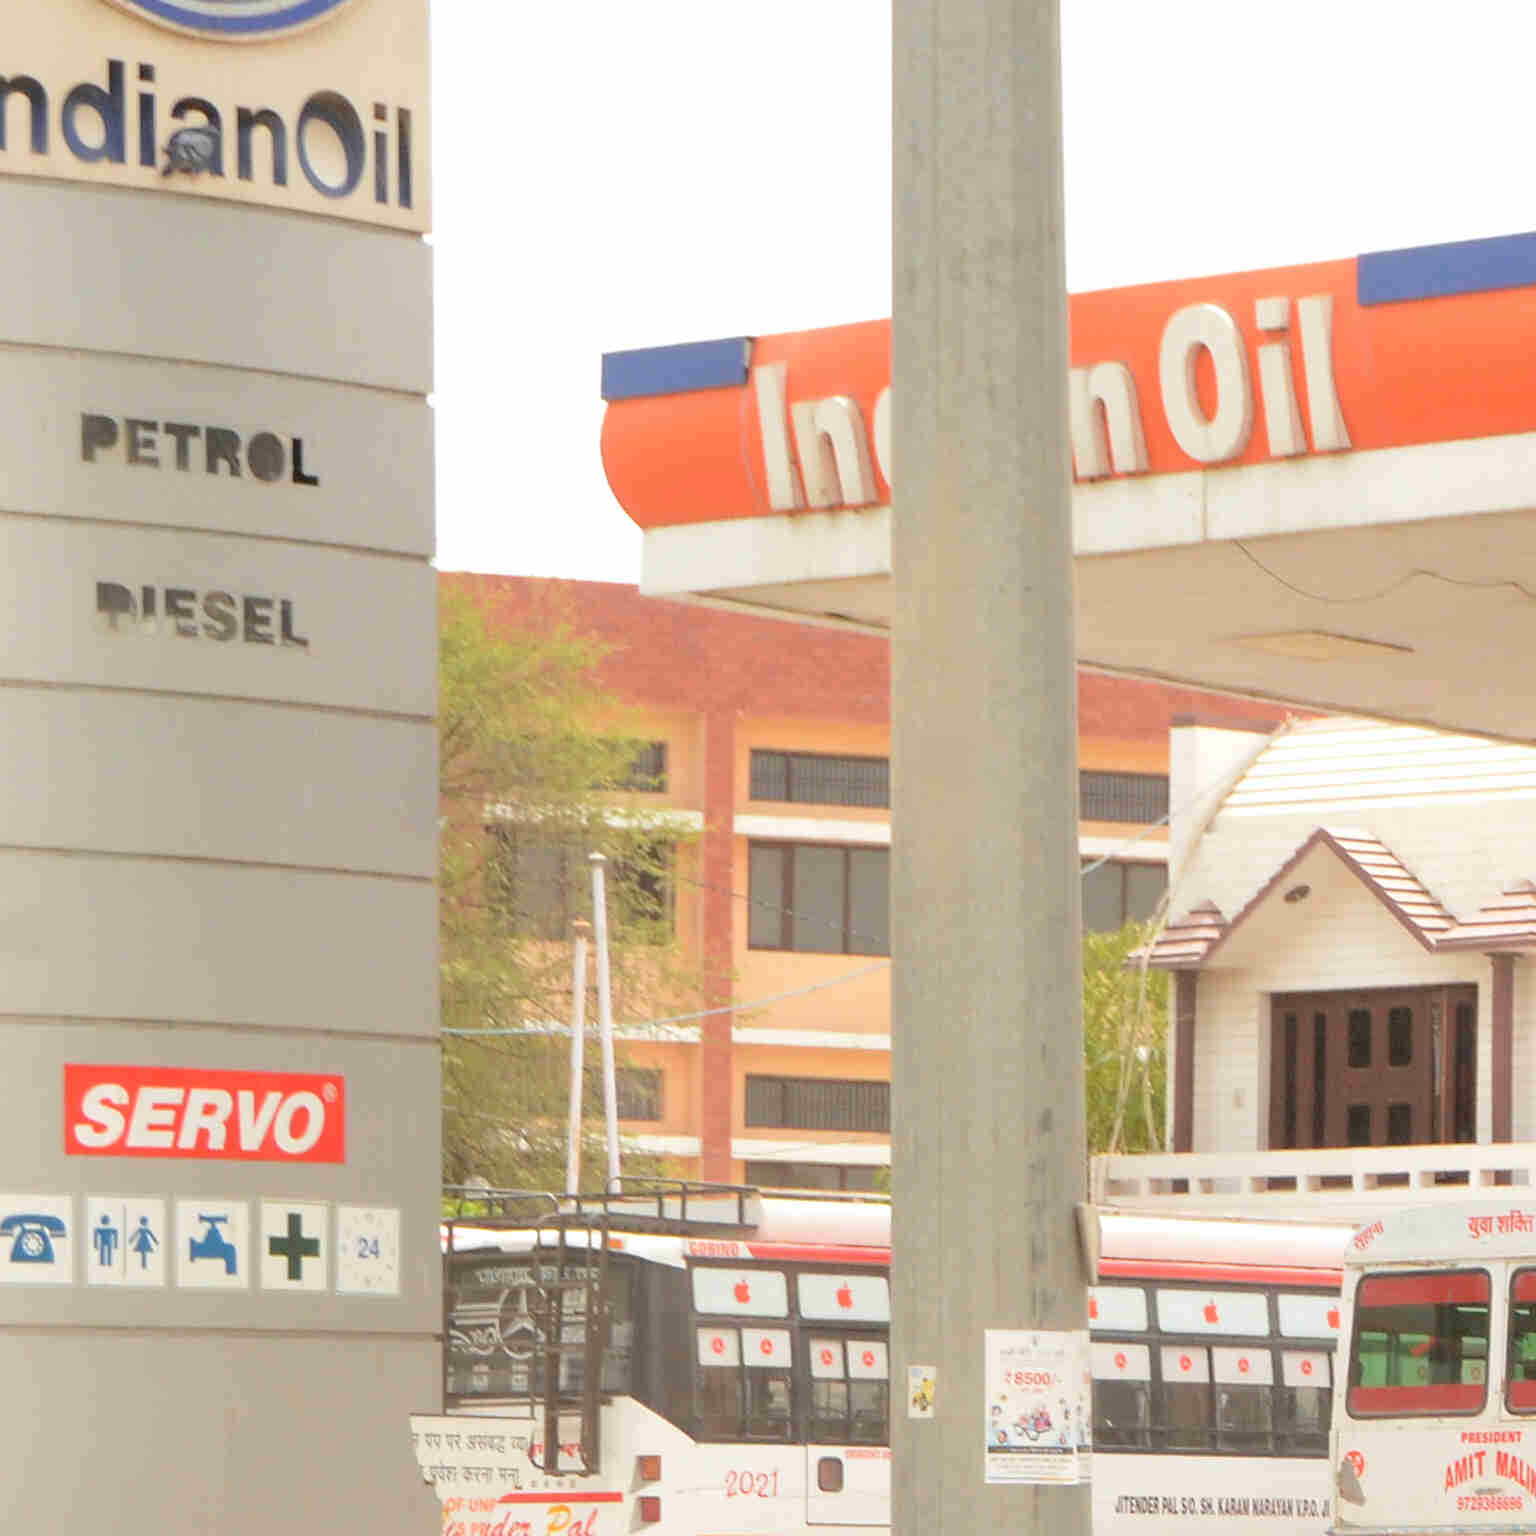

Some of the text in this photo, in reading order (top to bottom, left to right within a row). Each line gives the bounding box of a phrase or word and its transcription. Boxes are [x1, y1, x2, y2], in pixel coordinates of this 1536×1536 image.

[0, 59, 413, 208] ndianOil
[80, 411, 319, 487] PETROL
[95, 580, 310, 648] DIESEL
[73, 1083, 326, 1154] SERVO
[357, 1237, 381, 1260] 24
[1460, 1432, 1523, 1444] PRESIDENT
[724, 1469, 780, 1498] 2021
[1444, 1450, 1487, 1495] AMIT
